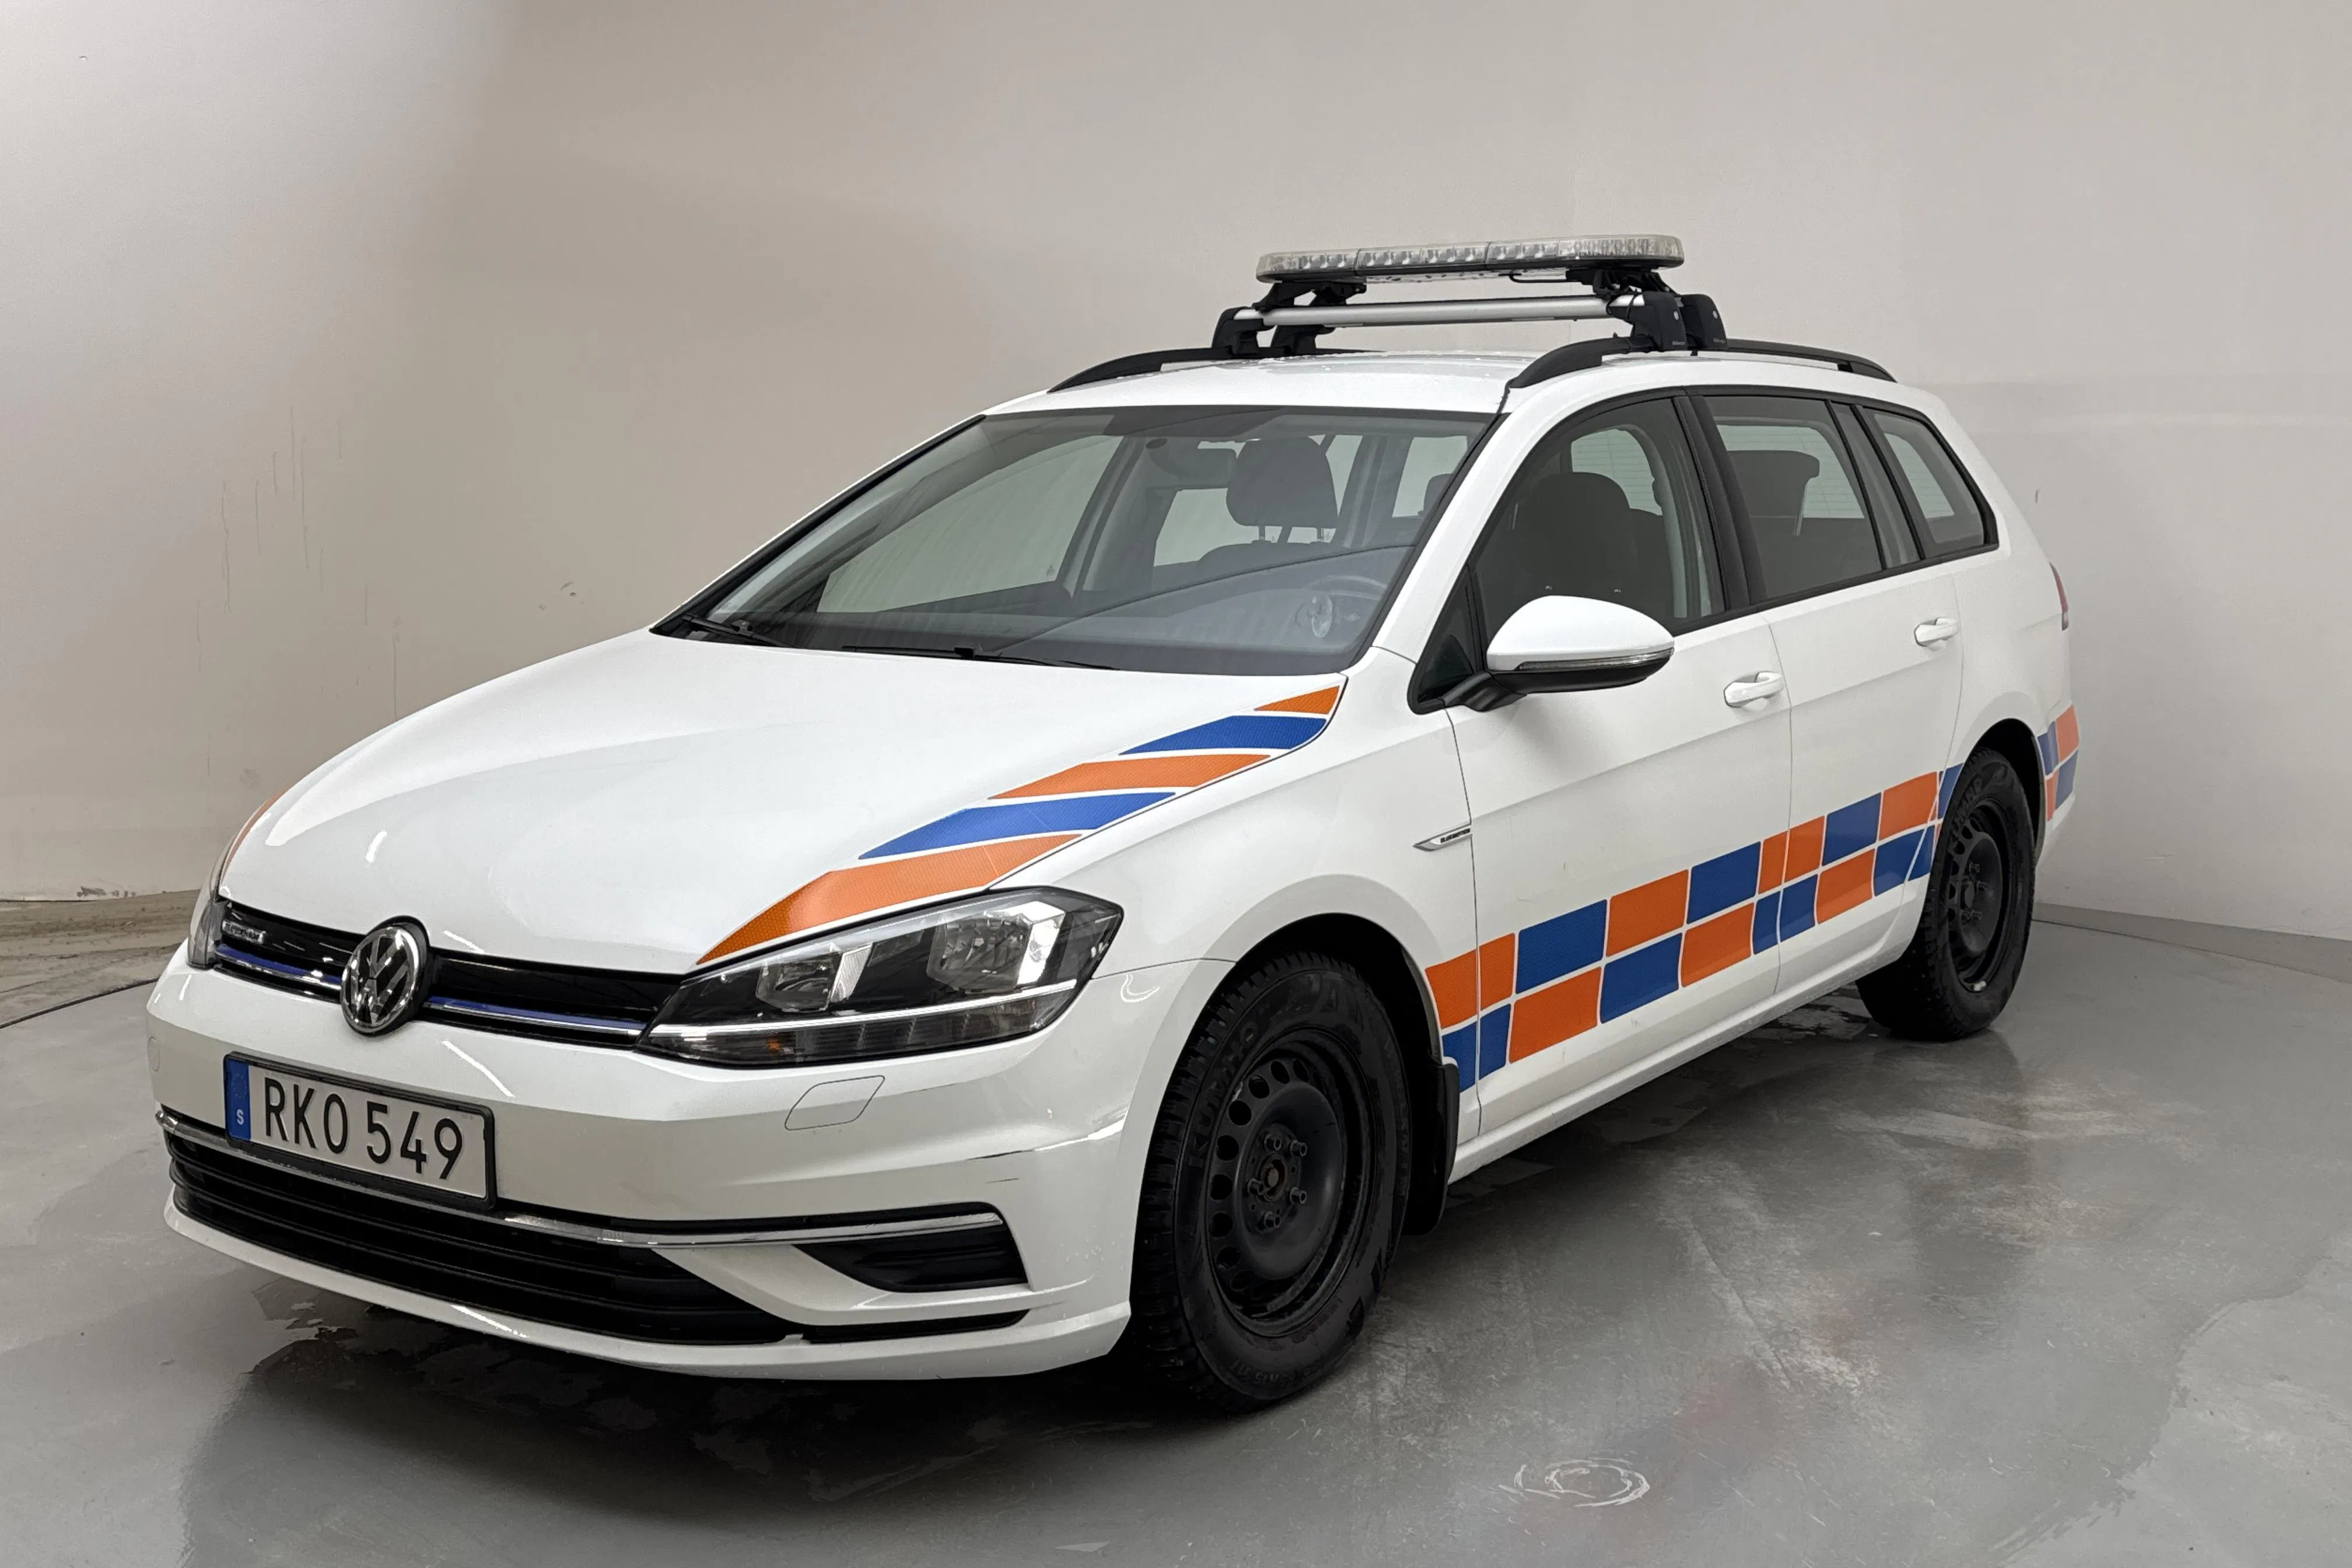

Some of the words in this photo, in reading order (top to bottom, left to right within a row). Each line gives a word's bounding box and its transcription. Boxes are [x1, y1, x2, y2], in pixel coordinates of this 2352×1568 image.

[236, 1108, 245, 1125] S
[264, 1077, 348, 1154] RKO
[366, 1101, 463, 1180] 549
[1186, 1020, 1259, 1168] KUMHO
